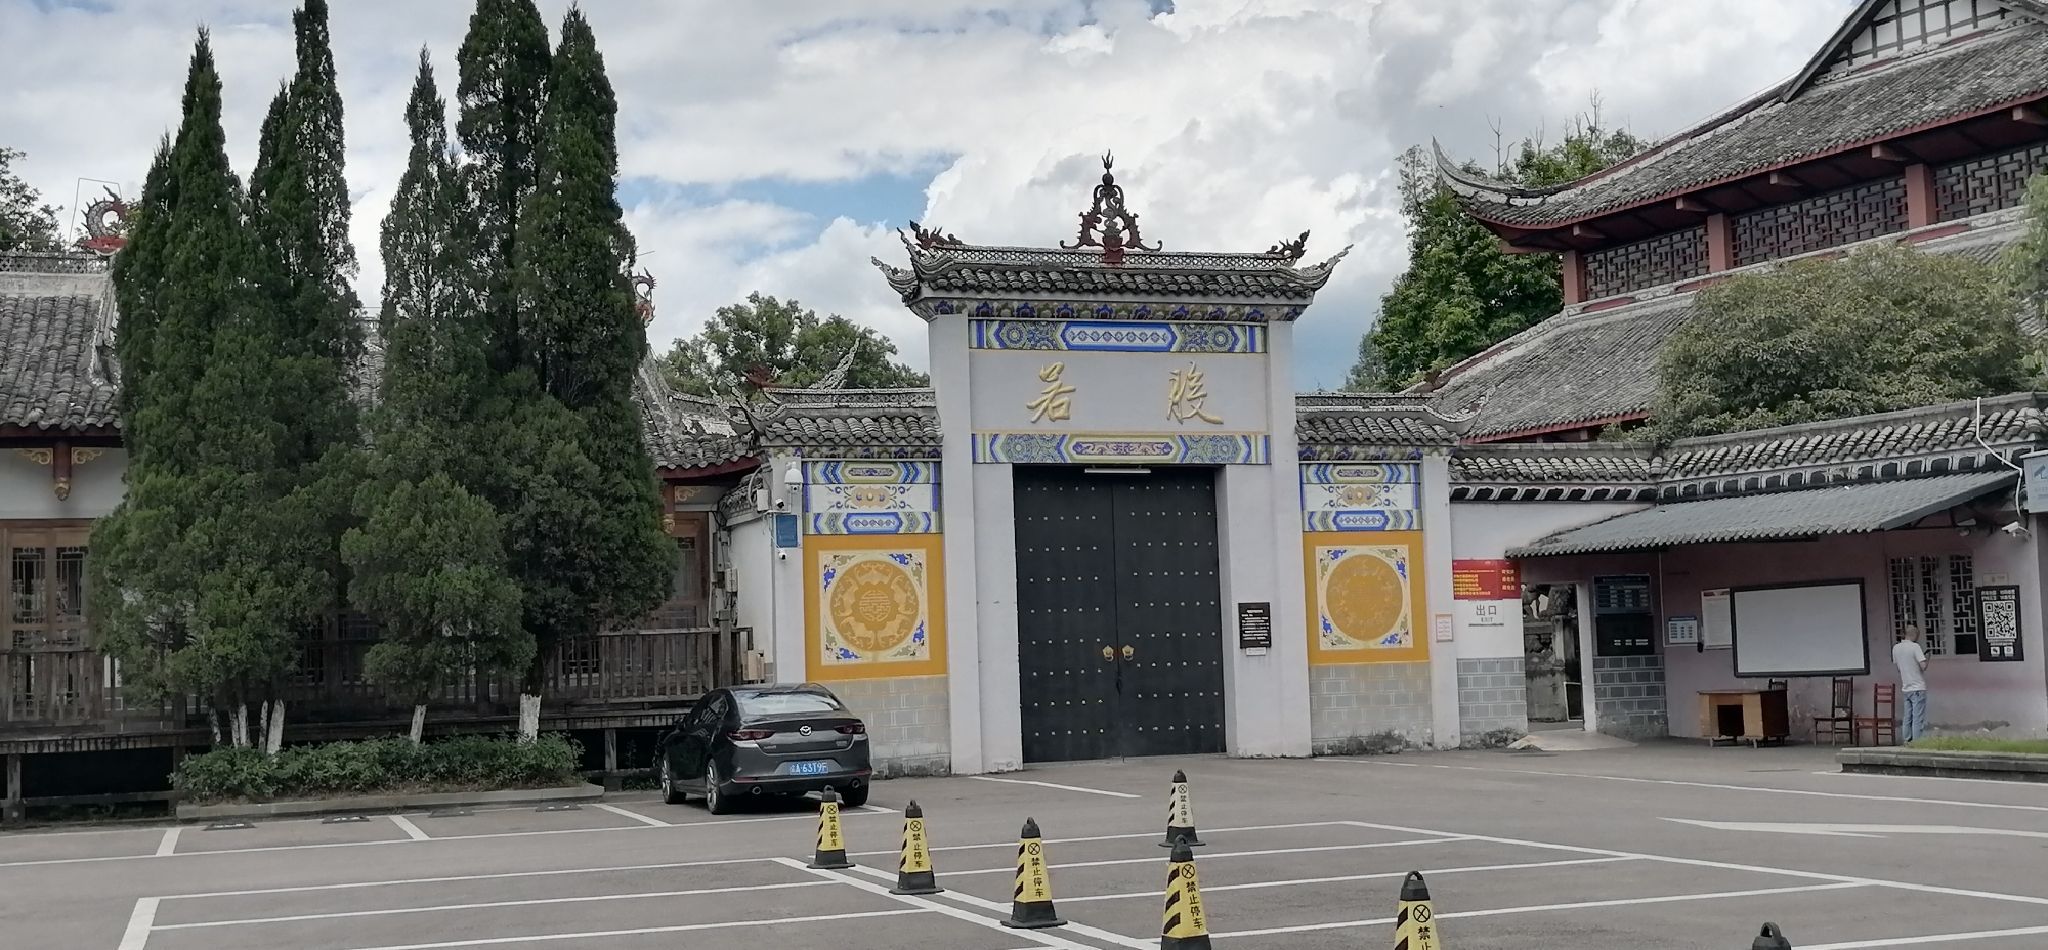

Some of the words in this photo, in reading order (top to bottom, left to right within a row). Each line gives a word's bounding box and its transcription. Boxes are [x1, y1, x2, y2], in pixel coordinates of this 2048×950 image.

[1476, 604, 1497, 616] 出口
[828, 816, 838, 847] 禁止停车
[912, 833, 923, 868] 禁止停车
[1032, 857, 1044, 898] 禁止停车
[1186, 881, 1203, 930] 禁止停车
